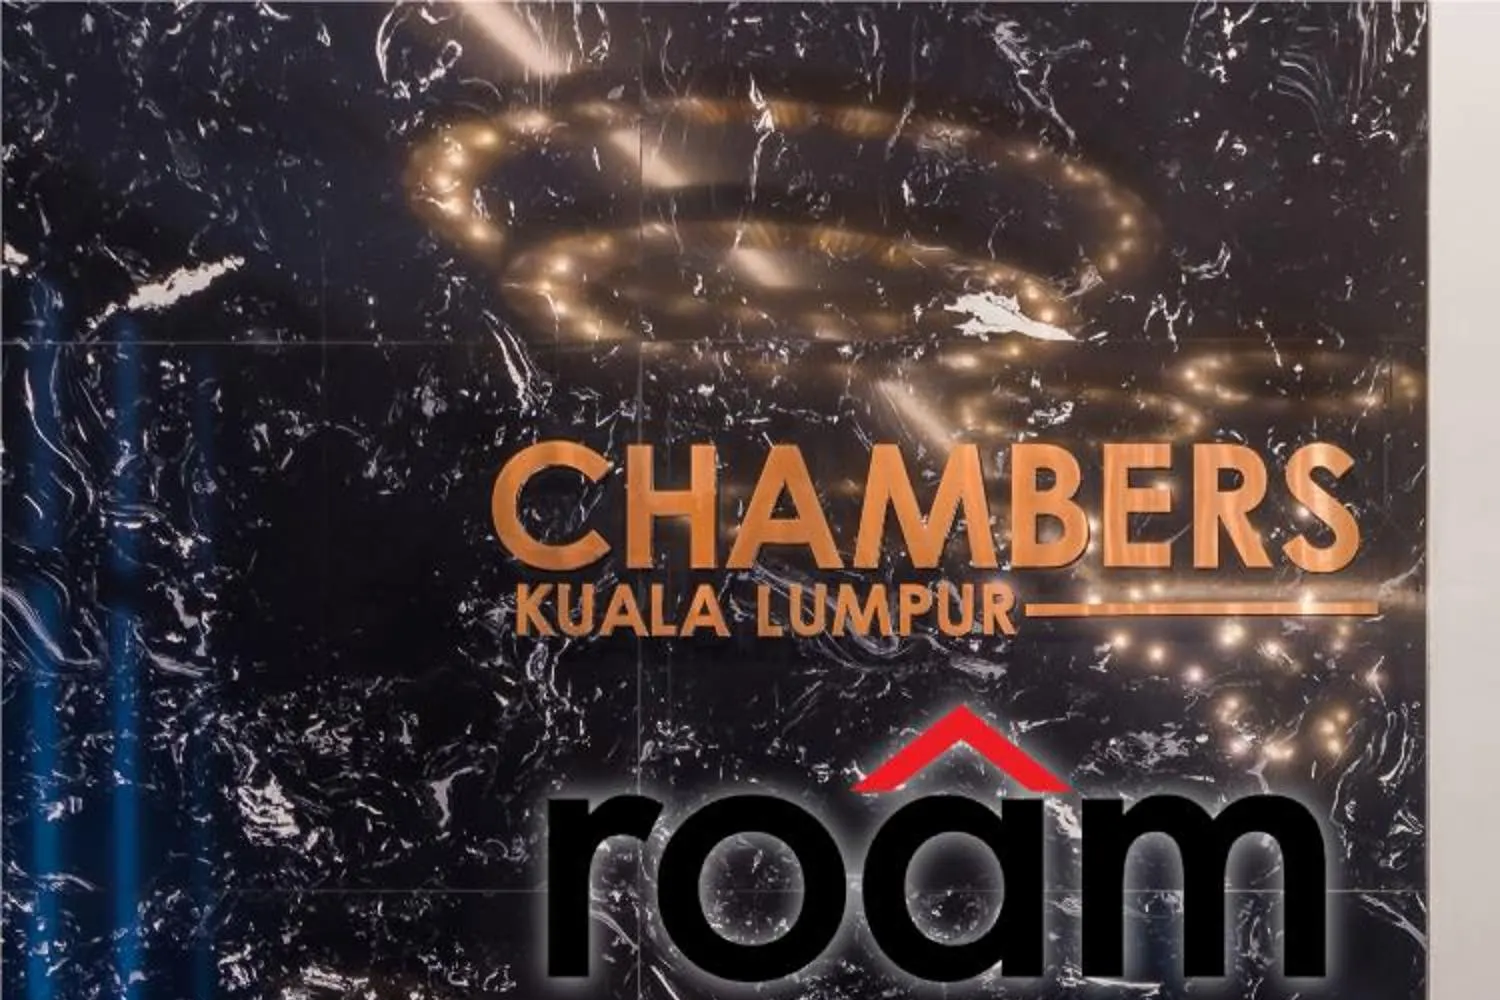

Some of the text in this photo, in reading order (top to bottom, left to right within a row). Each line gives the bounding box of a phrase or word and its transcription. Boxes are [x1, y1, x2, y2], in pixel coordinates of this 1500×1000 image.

[491, 439, 1362, 572] CHAMBERS
[515, 582, 1019, 637] KUALA LUMPUR
